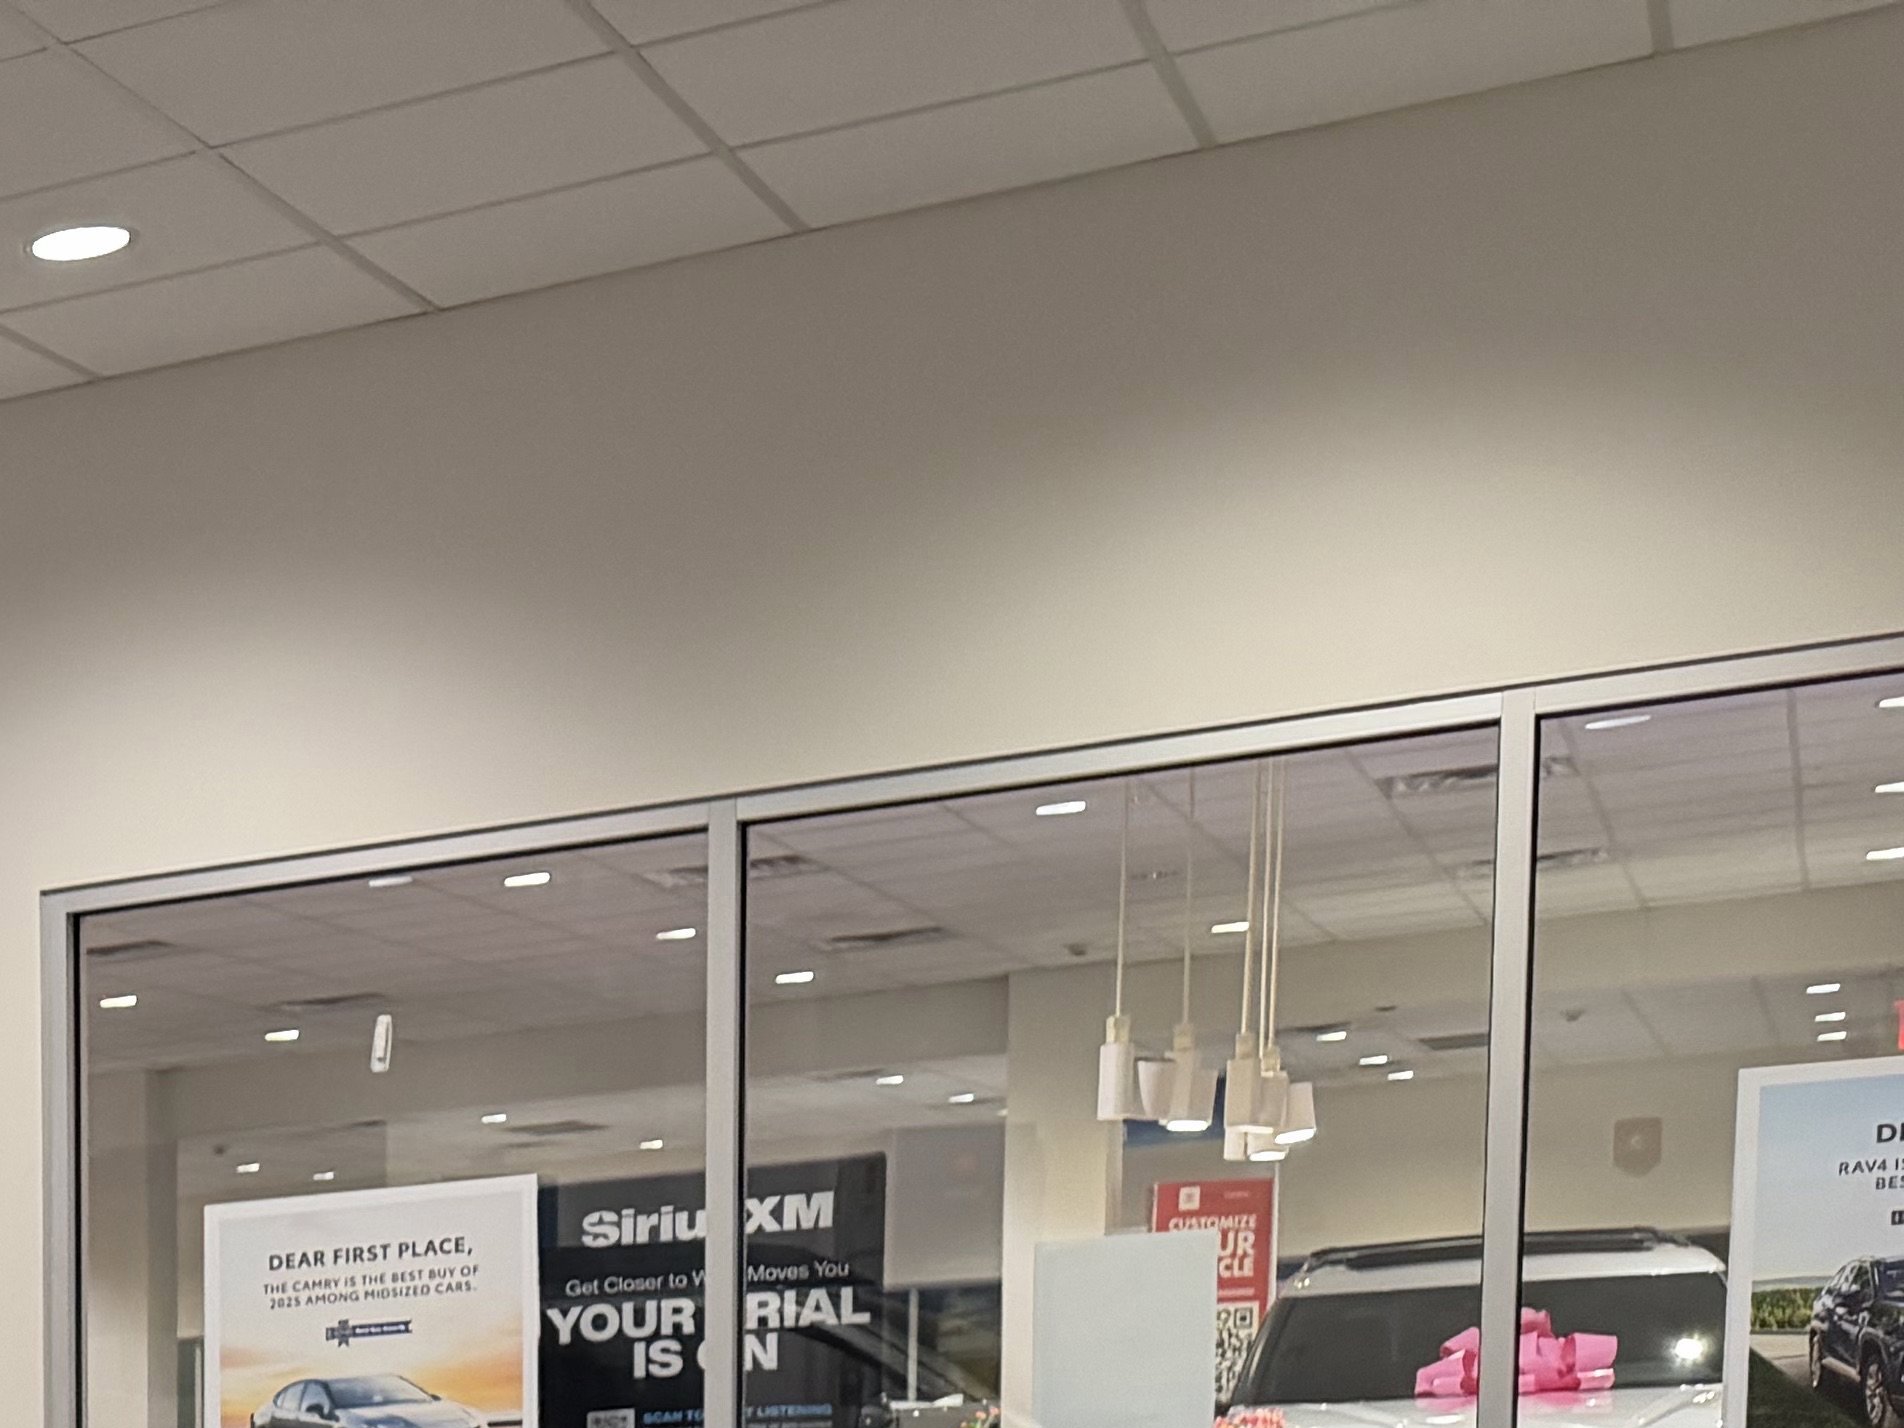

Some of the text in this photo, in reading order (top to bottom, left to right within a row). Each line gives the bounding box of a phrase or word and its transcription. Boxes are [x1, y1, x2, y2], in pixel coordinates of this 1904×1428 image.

[1838, 1157, 1904, 1177] RAV4 I
[581, 1190, 834, 1248] SiriuXM
[268, 1236, 473, 1271] DEAR FIRST PLACE,
[1218, 1230, 1255, 1257] UR
[264, 1264, 479, 1295] THE CAMRY IS THE BEST BUY OF
[565, 1277, 599, 1297] Get
[604, 1274, 664, 1294] Closer
[669, 1272, 688, 1289] to
[747, 1264, 810, 1282] Moves
[814, 1260, 849, 1278] You
[270, 1296, 301, 1309] 2025
[305, 1291, 360, 1306] AMONG
[364, 1284, 430, 1300] MIDSIZED
[545, 1286, 871, 1346] YOUR RIAL
[633, 1338, 684, 1379] IS
